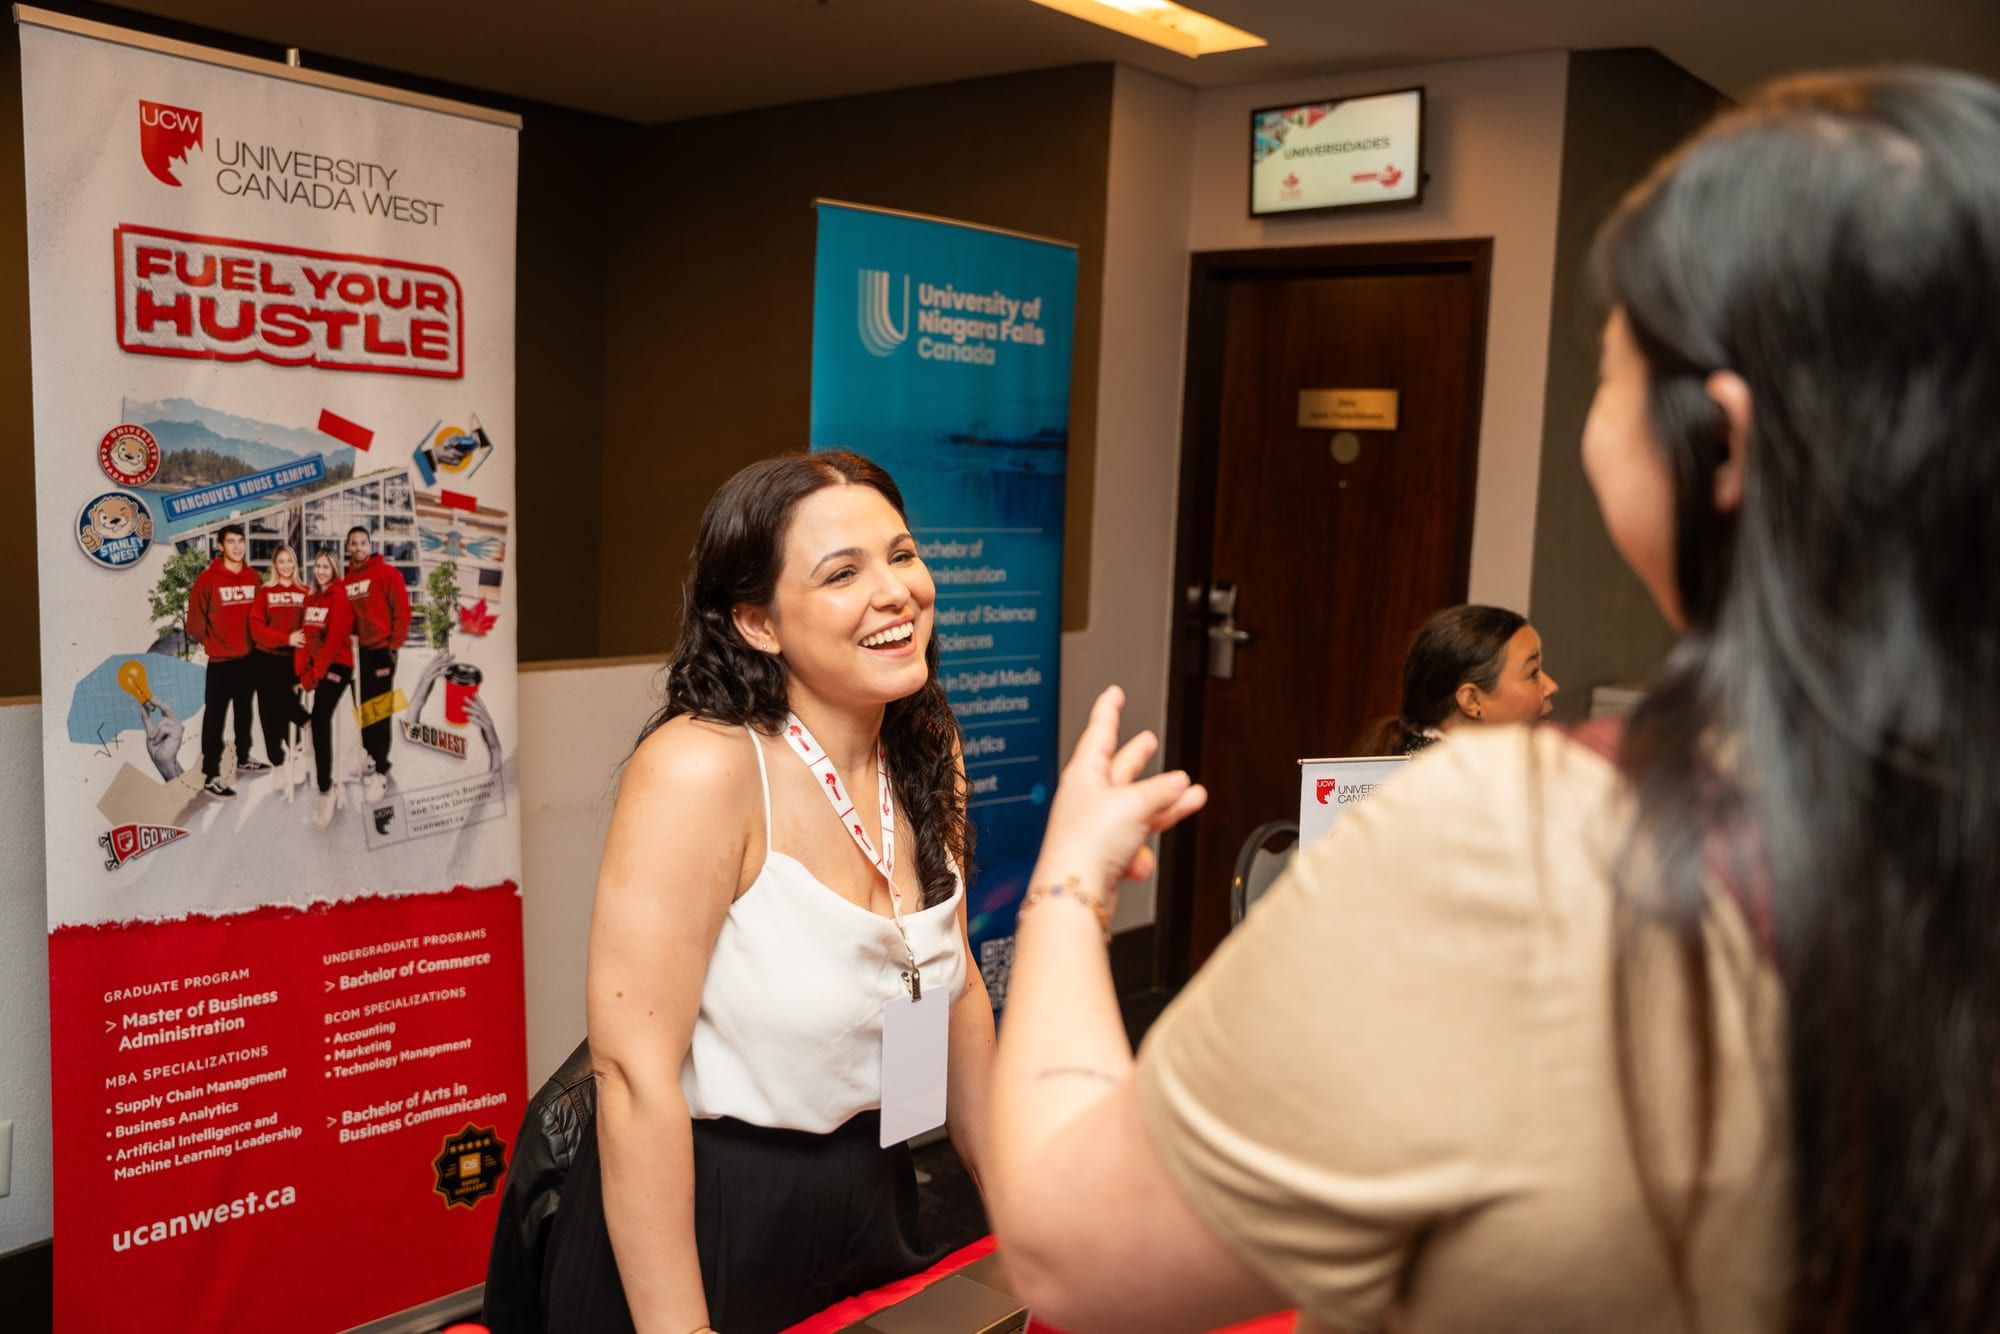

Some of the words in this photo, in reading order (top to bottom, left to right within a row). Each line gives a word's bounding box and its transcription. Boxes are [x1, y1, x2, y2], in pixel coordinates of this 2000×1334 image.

[141, 106, 200, 133] UCW
[216, 137, 397, 190] UNIVERSITY
[216, 168, 356, 213] CANADA
[362, 190, 445, 226] WEST
[136, 246, 294, 296] FUEL
[301, 266, 448, 312] YOUR
[918, 283, 1020, 323] University
[1022, 297, 1042, 320] of
[136, 288, 449, 361] HUSTLE
[918, 310, 998, 343] Niagara
[1001, 320, 1045, 345] Falls
[917, 336, 996, 365] Canada
[172, 486, 238, 514] VANCOUVER
[239, 476, 274, 496] HOUSE
[276, 463, 317, 485] CAMPUS
[100, 536, 144, 558] STANLEY
[110, 549, 139, 565] WEST
[916, 539, 968, 558] achelor
[219, 585, 255, 601] UCW
[931, 566, 1007, 585] ministration
[268, 592, 305, 604] UCW
[951, 696, 1029, 716] munications
[410, 725, 466, 755] #GOWEST
[962, 736, 1006, 757] alytics
[1317, 780, 1335, 788] UCW
[141, 828, 159, 849] GO
[323, 937, 420, 966] UNDERGRADUATE
[423, 928, 487, 947] PROGRAMS
[104, 979, 179, 1003] GRADUATE
[184, 968, 250, 989] PROGRAM
[340, 967, 397, 991] Bachelor
[400, 961, 415, 977] of
[417, 952, 491, 974] Commerce
[122, 1008, 183, 1029] Master
[187, 1001, 205, 1018] of
[208, 991, 278, 1014] Business
[325, 1008, 360, 1025] BCOM
[364, 987, 466, 1016] SPECIALIZATIONS
[119, 1017, 245, 1051] Administration
[333, 1021, 396, 1044] Accounting
[334, 1039, 392, 1061] Marketing
[105, 1072, 137, 1089] MBA
[143, 1045, 269, 1081] SPECIALIZATIONS
[334, 1054, 398, 1078] Technology
[400, 1038, 472, 1062] Management
[115, 1094, 163, 1115] Supply
[166, 1087, 204, 1103] Chain
[207, 1067, 288, 1095] Management
[342, 1100, 403, 1126] Bachelor
[406, 1092, 420, 1109] of
[422, 1087, 451, 1104] Arts
[454, 1082, 468, 1096] in
[115, 1115, 175, 1139] Business
[178, 1102, 239, 1124] Analytics
[115, 1137, 175, 1161] Artificial
[179, 1121, 251, 1147] Intelligence
[254, 1112, 278, 1129] and
[339, 1118, 402, 1144] Business
[404, 1092, 507, 1128] Communication
[114, 1158, 172, 1181] Machine
[175, 1144, 232, 1167] Learning
[235, 1126, 303, 1151] Leadership
[112, 1185, 296, 1252] ucanwest.ca
